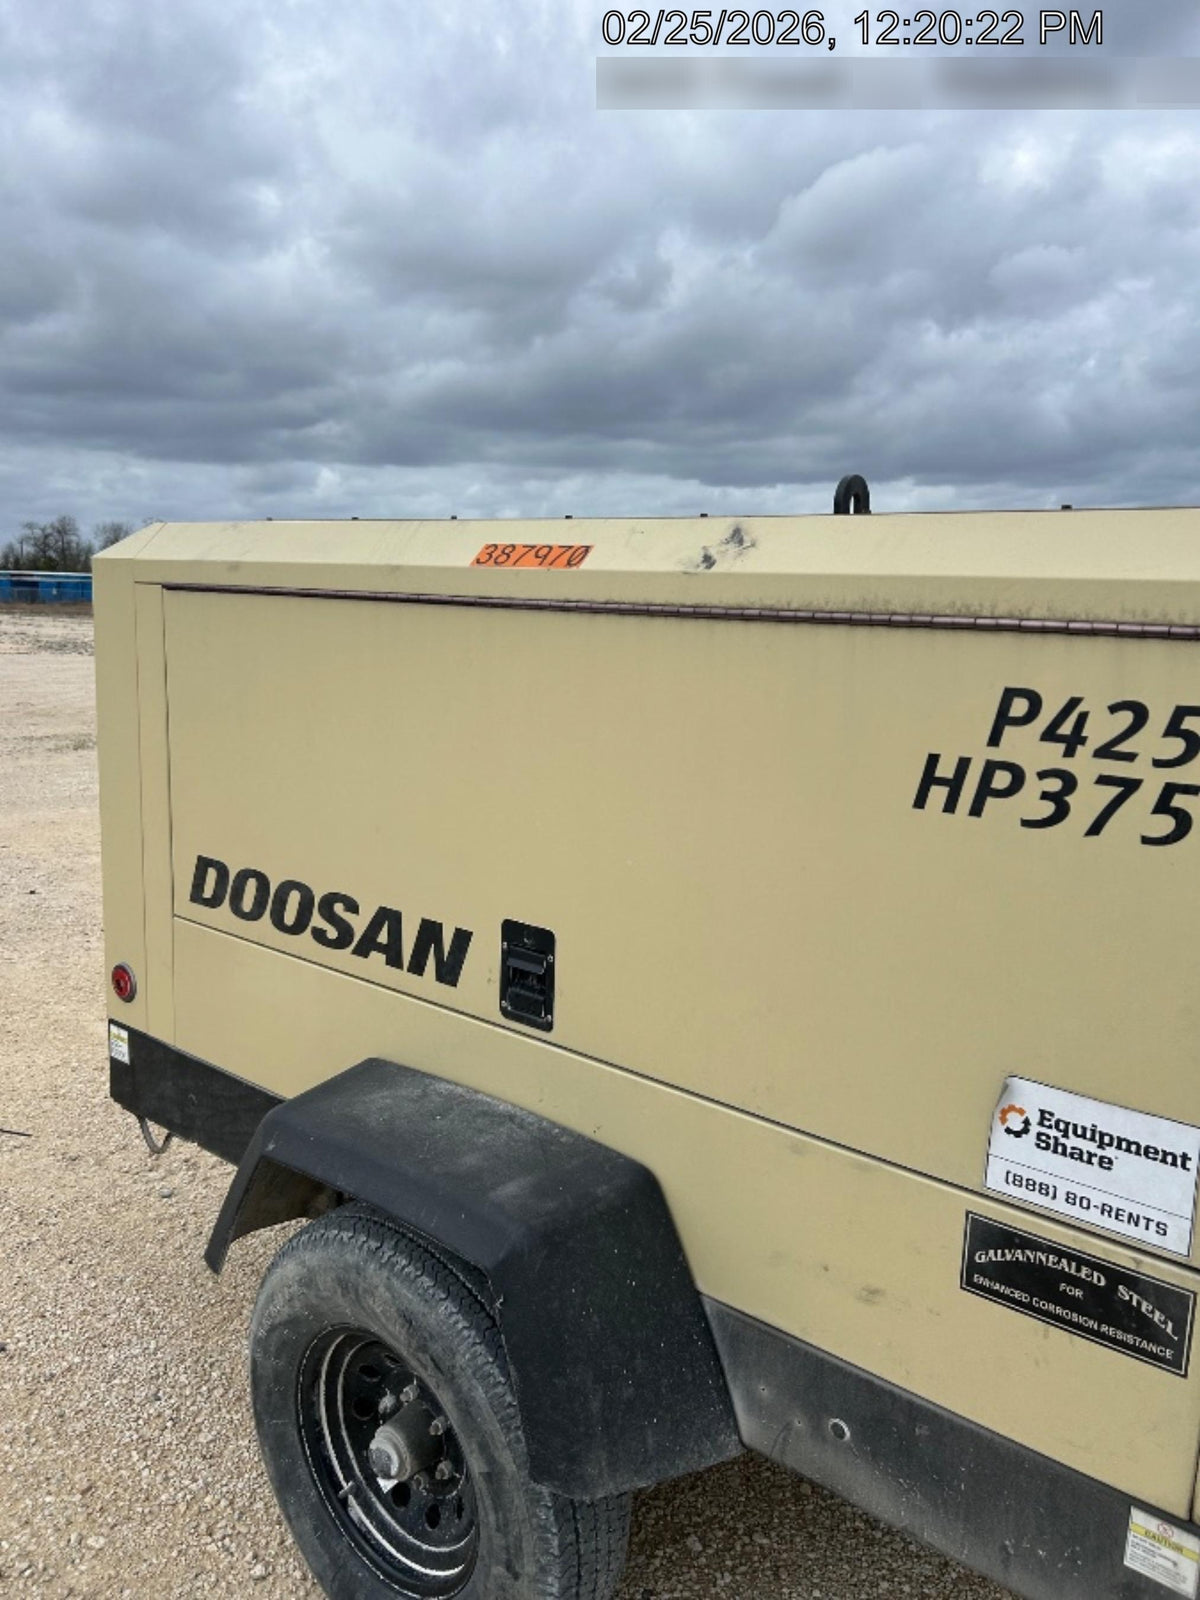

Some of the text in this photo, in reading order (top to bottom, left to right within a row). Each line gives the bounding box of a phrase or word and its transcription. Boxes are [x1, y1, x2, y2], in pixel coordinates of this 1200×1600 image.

[476, 543, 591, 568] 387970
[986, 686, 1200, 769] P425
[912, 753, 1200, 846] HP375
[189, 854, 473, 988] DOOSAN
[1034, 1131, 1115, 1172] Share
[1035, 1108, 1193, 1172] Equipment
[1004, 1169, 1169, 1238] (888) 80-RENTS
[973, 1274, 1175, 1360] ENHANCED CORROSION RESISTANCE
[975, 1249, 1179, 1341] GALVANNEALED STEEL
[1058, 1282, 1084, 1300] FOR
